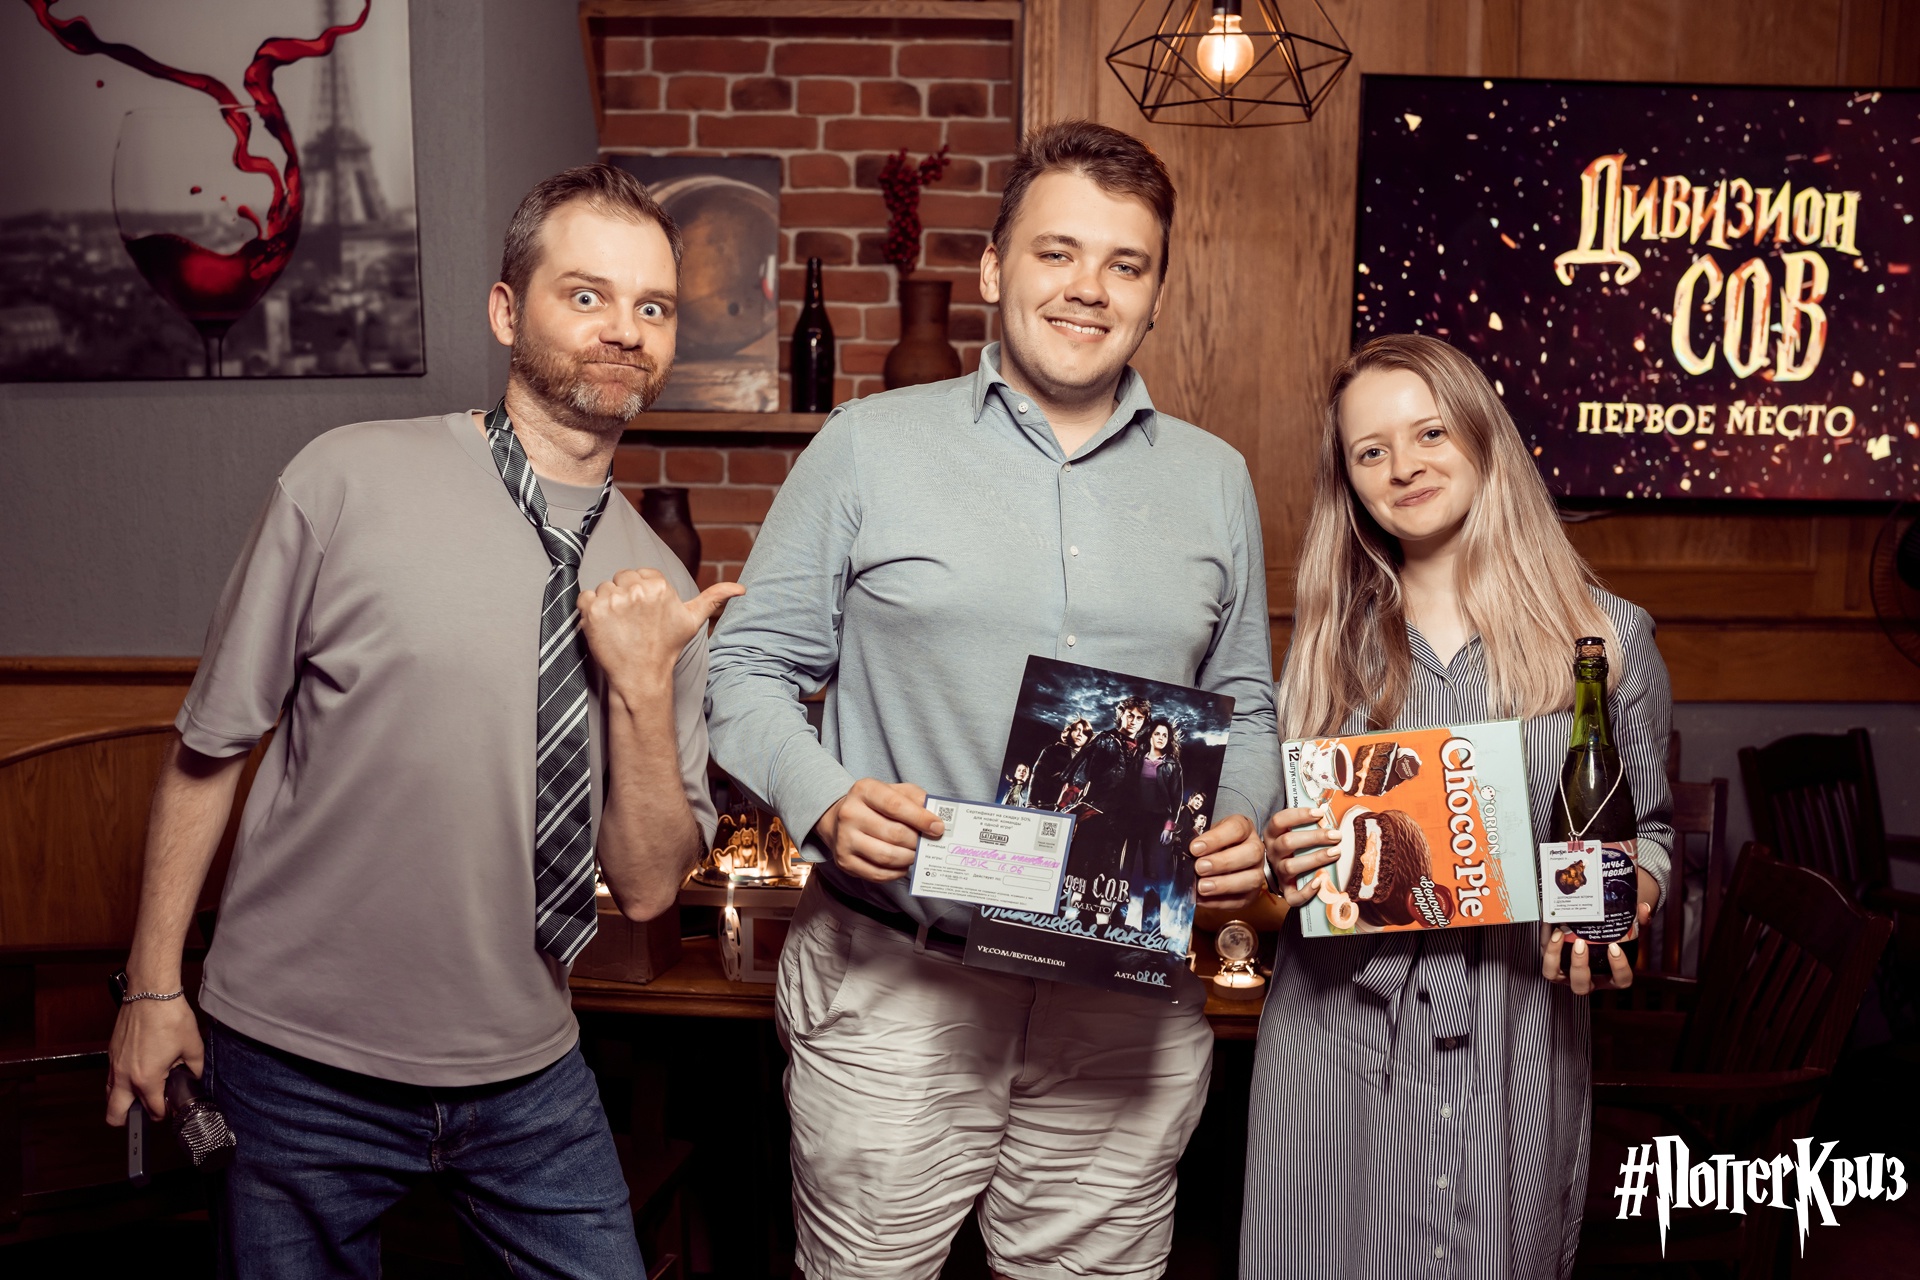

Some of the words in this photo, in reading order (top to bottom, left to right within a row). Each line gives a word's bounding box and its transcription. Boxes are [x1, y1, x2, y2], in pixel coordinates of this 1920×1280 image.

[1671, 251, 1830, 382] СОВ
[1578, 401, 1716, 435] ПЕРВОЕ
[1726, 401, 1857, 437] МЕСТО
[1288, 746, 1300, 762] 12
[1483, 802, 1501, 856] ORION
[1073, 901, 1112, 914] МЕСТО
